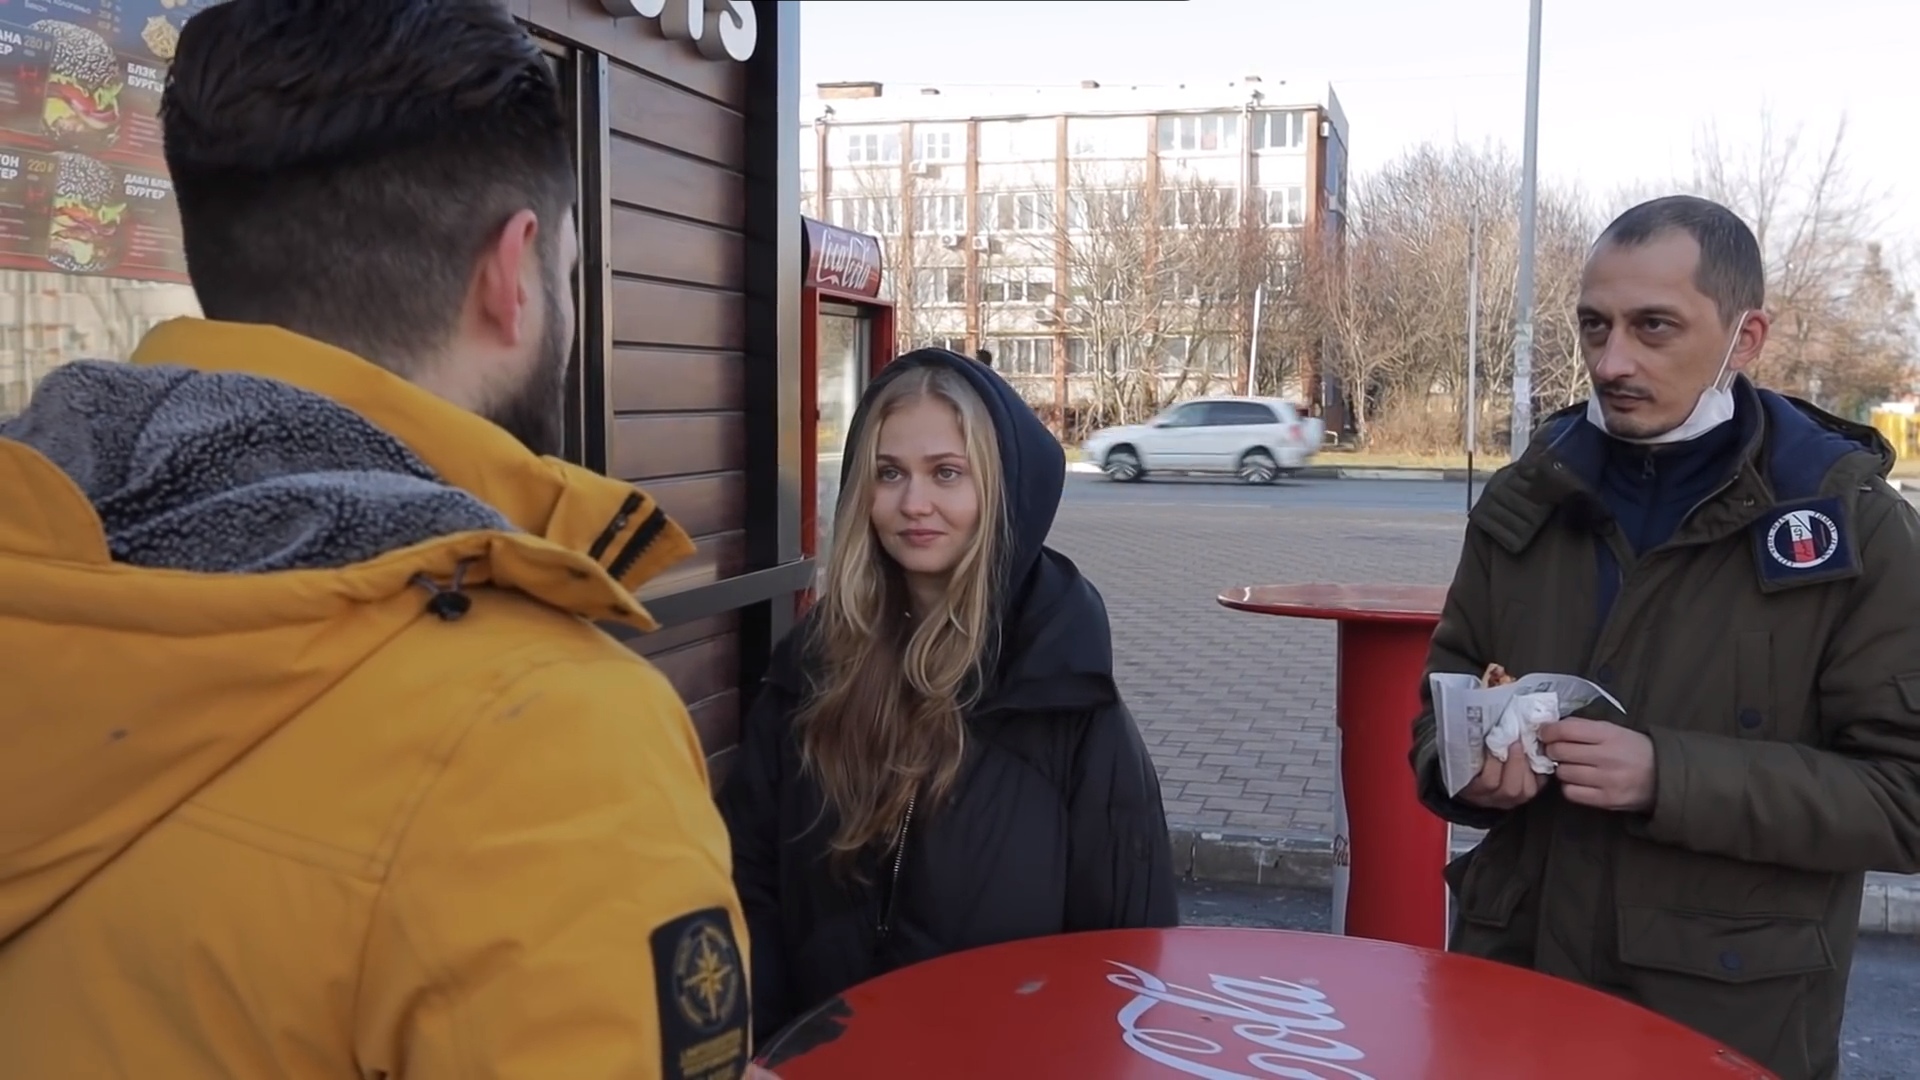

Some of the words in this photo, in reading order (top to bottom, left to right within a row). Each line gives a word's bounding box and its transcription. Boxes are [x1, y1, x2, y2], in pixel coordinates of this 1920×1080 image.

[127, 62, 157, 79] БЛЭК
[0, 153, 20, 168] ОН
[125, 185, 165, 200] БУРГЕР
